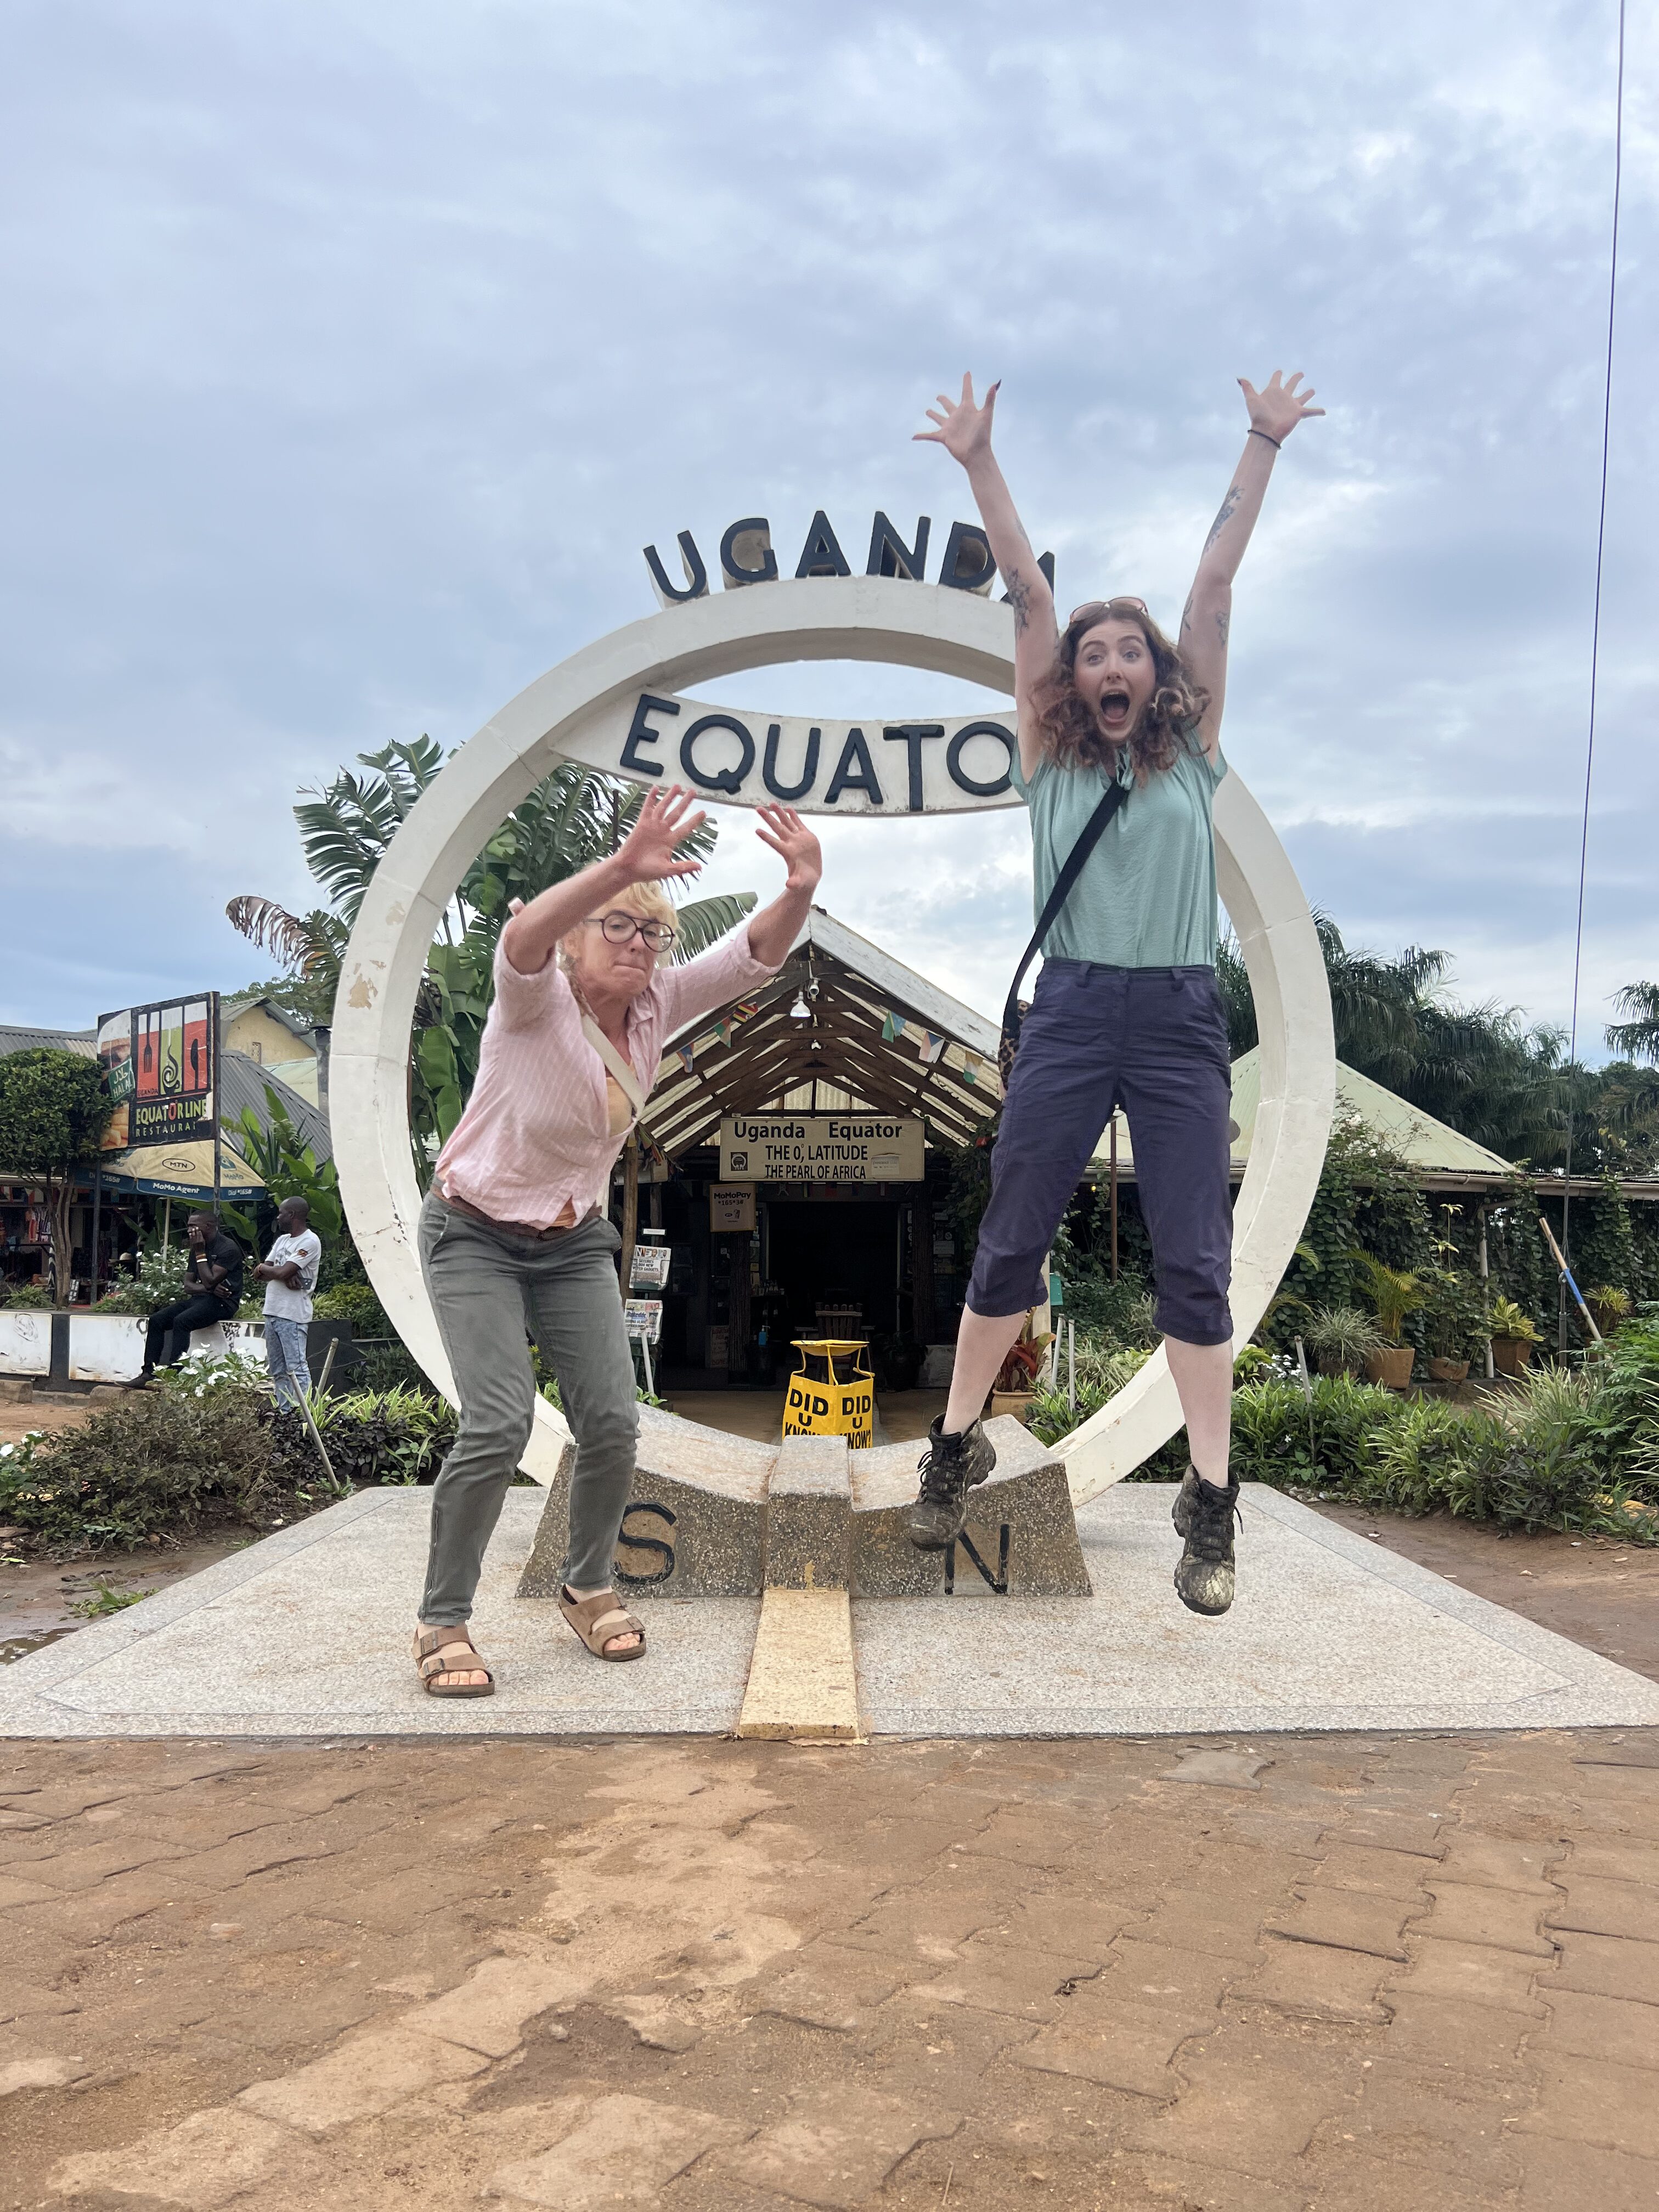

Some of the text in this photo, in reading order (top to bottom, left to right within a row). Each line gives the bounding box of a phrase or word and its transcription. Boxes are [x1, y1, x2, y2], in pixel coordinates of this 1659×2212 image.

[619, 693, 1017, 812] EQUATO
[734, 1122, 902, 1142] Uganda Equator
[765, 1145, 790, 1160] THE
[808, 1145, 868, 1160] LATITUDE
[765, 1164, 866, 1179] THE PEARL OF AFRICA
[153, 1182, 200, 1194] MoMo Agent
[714, 1191, 752, 1200] MoMoPay
[789, 1388, 829, 1416] DID
[842, 1395, 871, 1416] DID
[798, 1412, 812, 1427] U
[852, 1417, 862, 1429] U
[785, 1421, 821, 1436] KN
[839, 1429, 871, 1449] NOW?
[613, 1502, 677, 1585] S
[944, 1523, 1011, 1596] N
